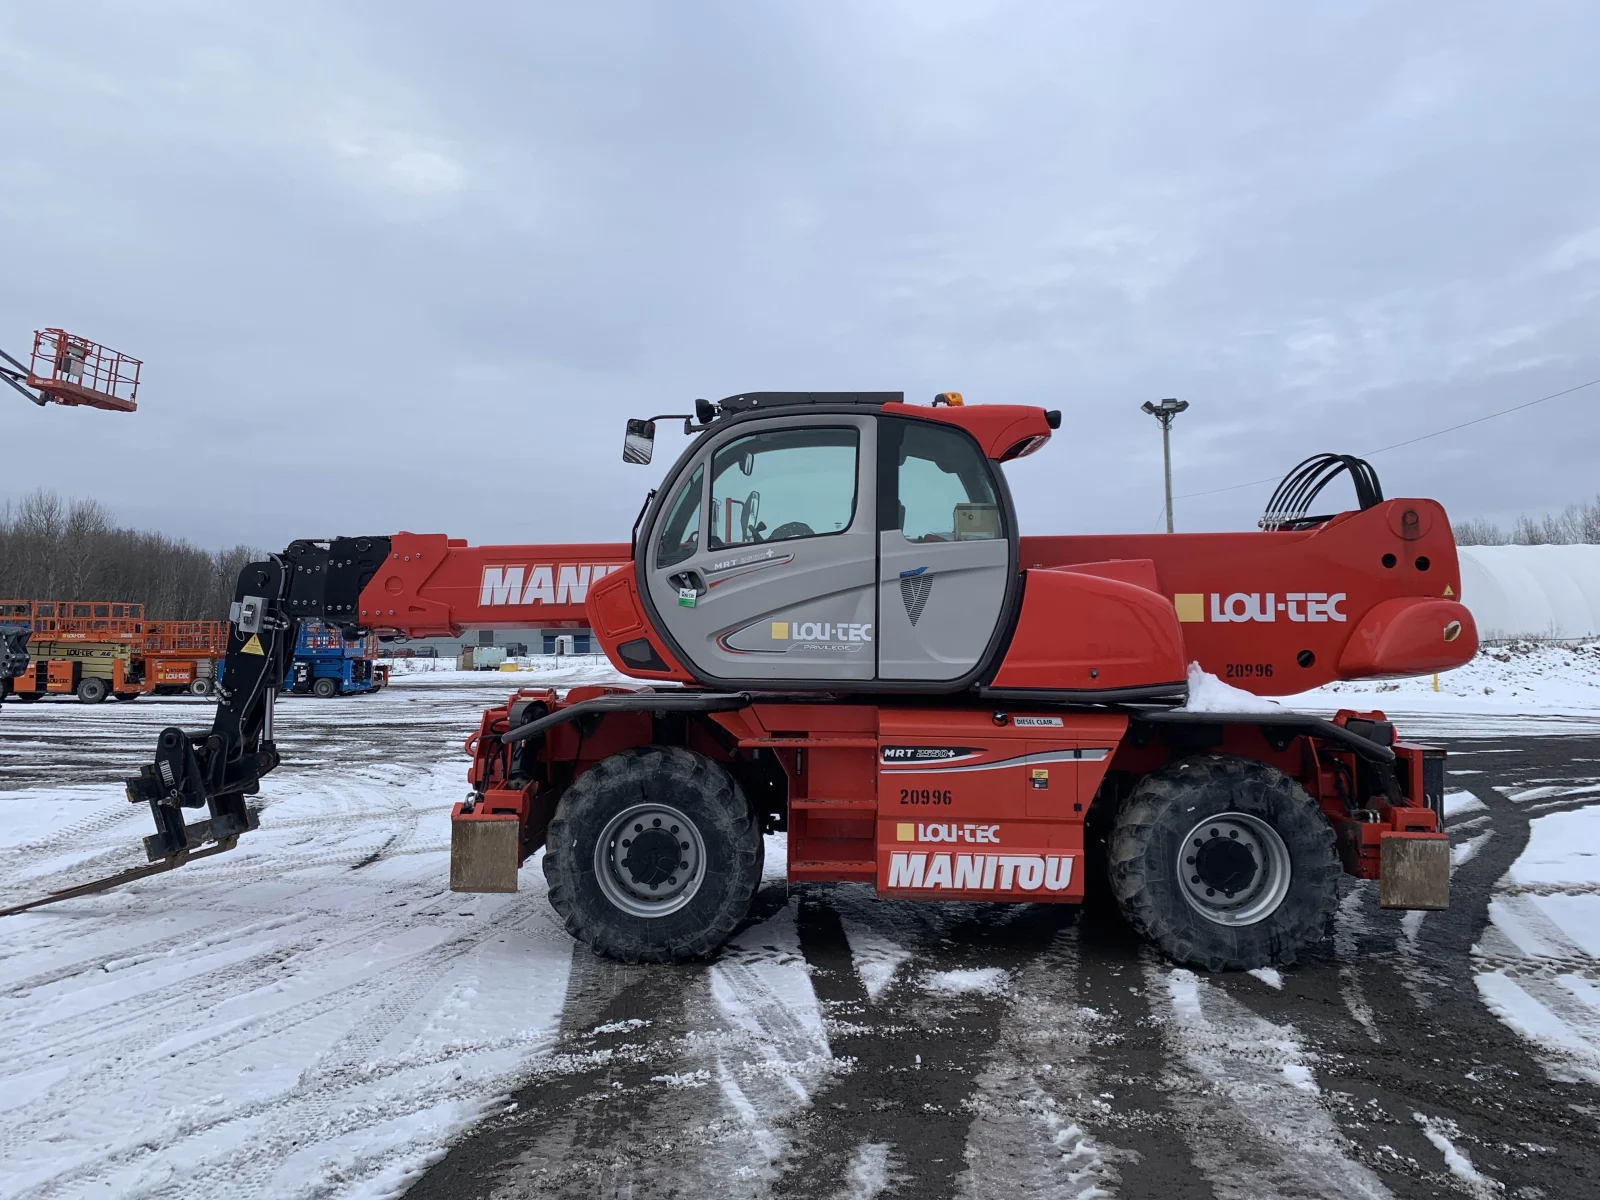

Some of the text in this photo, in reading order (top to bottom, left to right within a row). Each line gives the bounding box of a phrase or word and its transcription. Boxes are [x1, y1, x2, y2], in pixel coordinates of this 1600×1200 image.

[714, 559, 738, 570] MRT
[478, 564, 624, 607] MAN
[1210, 592, 1347, 623] LOU-TEC
[792, 622, 872, 642] LOU-TEC
[66, 649, 94, 657] LOU-TEC
[1225, 663, 1273, 678] 20996
[884, 748, 915, 758] MRT
[899, 788, 952, 806] 20996
[918, 823, 1000, 843] LOU-TEC
[887, 851, 1075, 891] MANITOU
